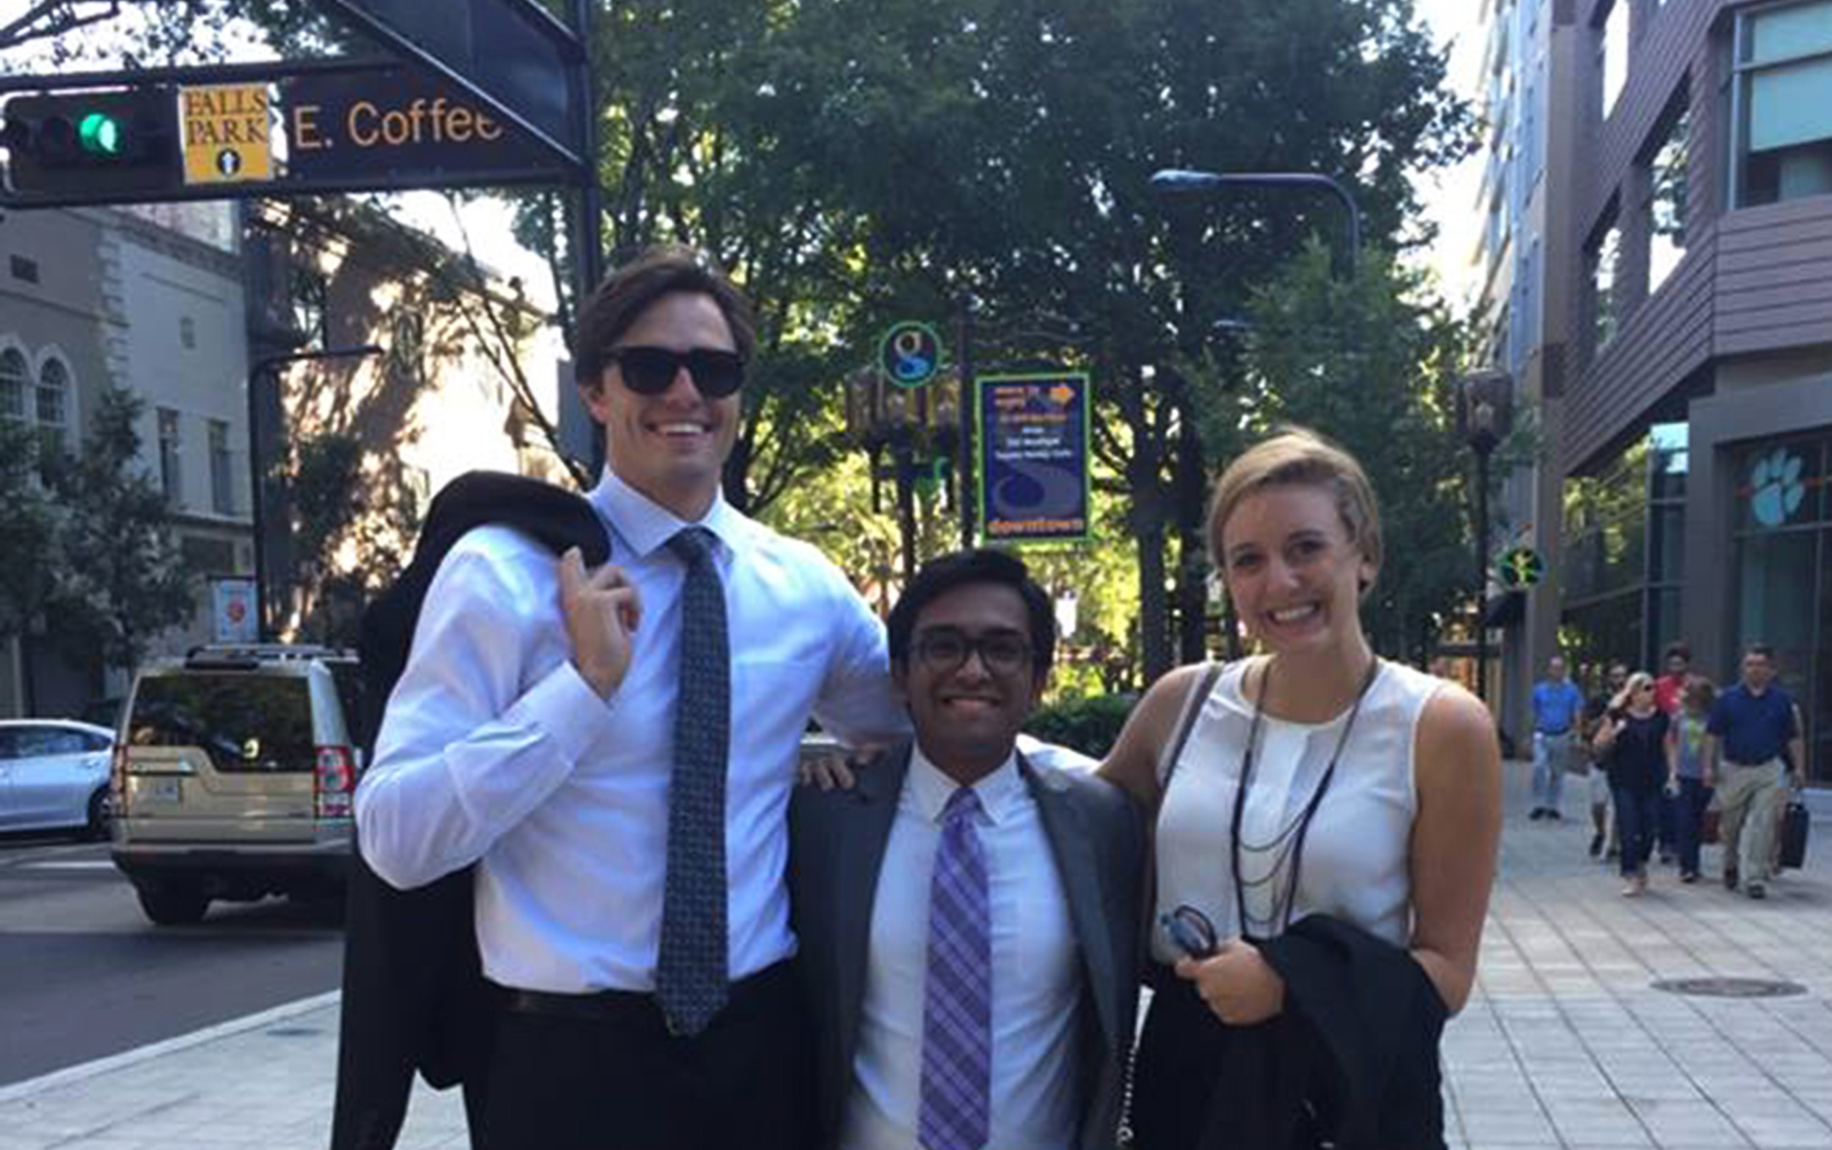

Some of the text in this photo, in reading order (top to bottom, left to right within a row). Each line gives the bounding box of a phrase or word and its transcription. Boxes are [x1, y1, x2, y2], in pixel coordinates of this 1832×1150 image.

[186, 90, 268, 116] FALLS
[185, 119, 268, 144] PARK
[294, 99, 504, 149] E. Coffee
